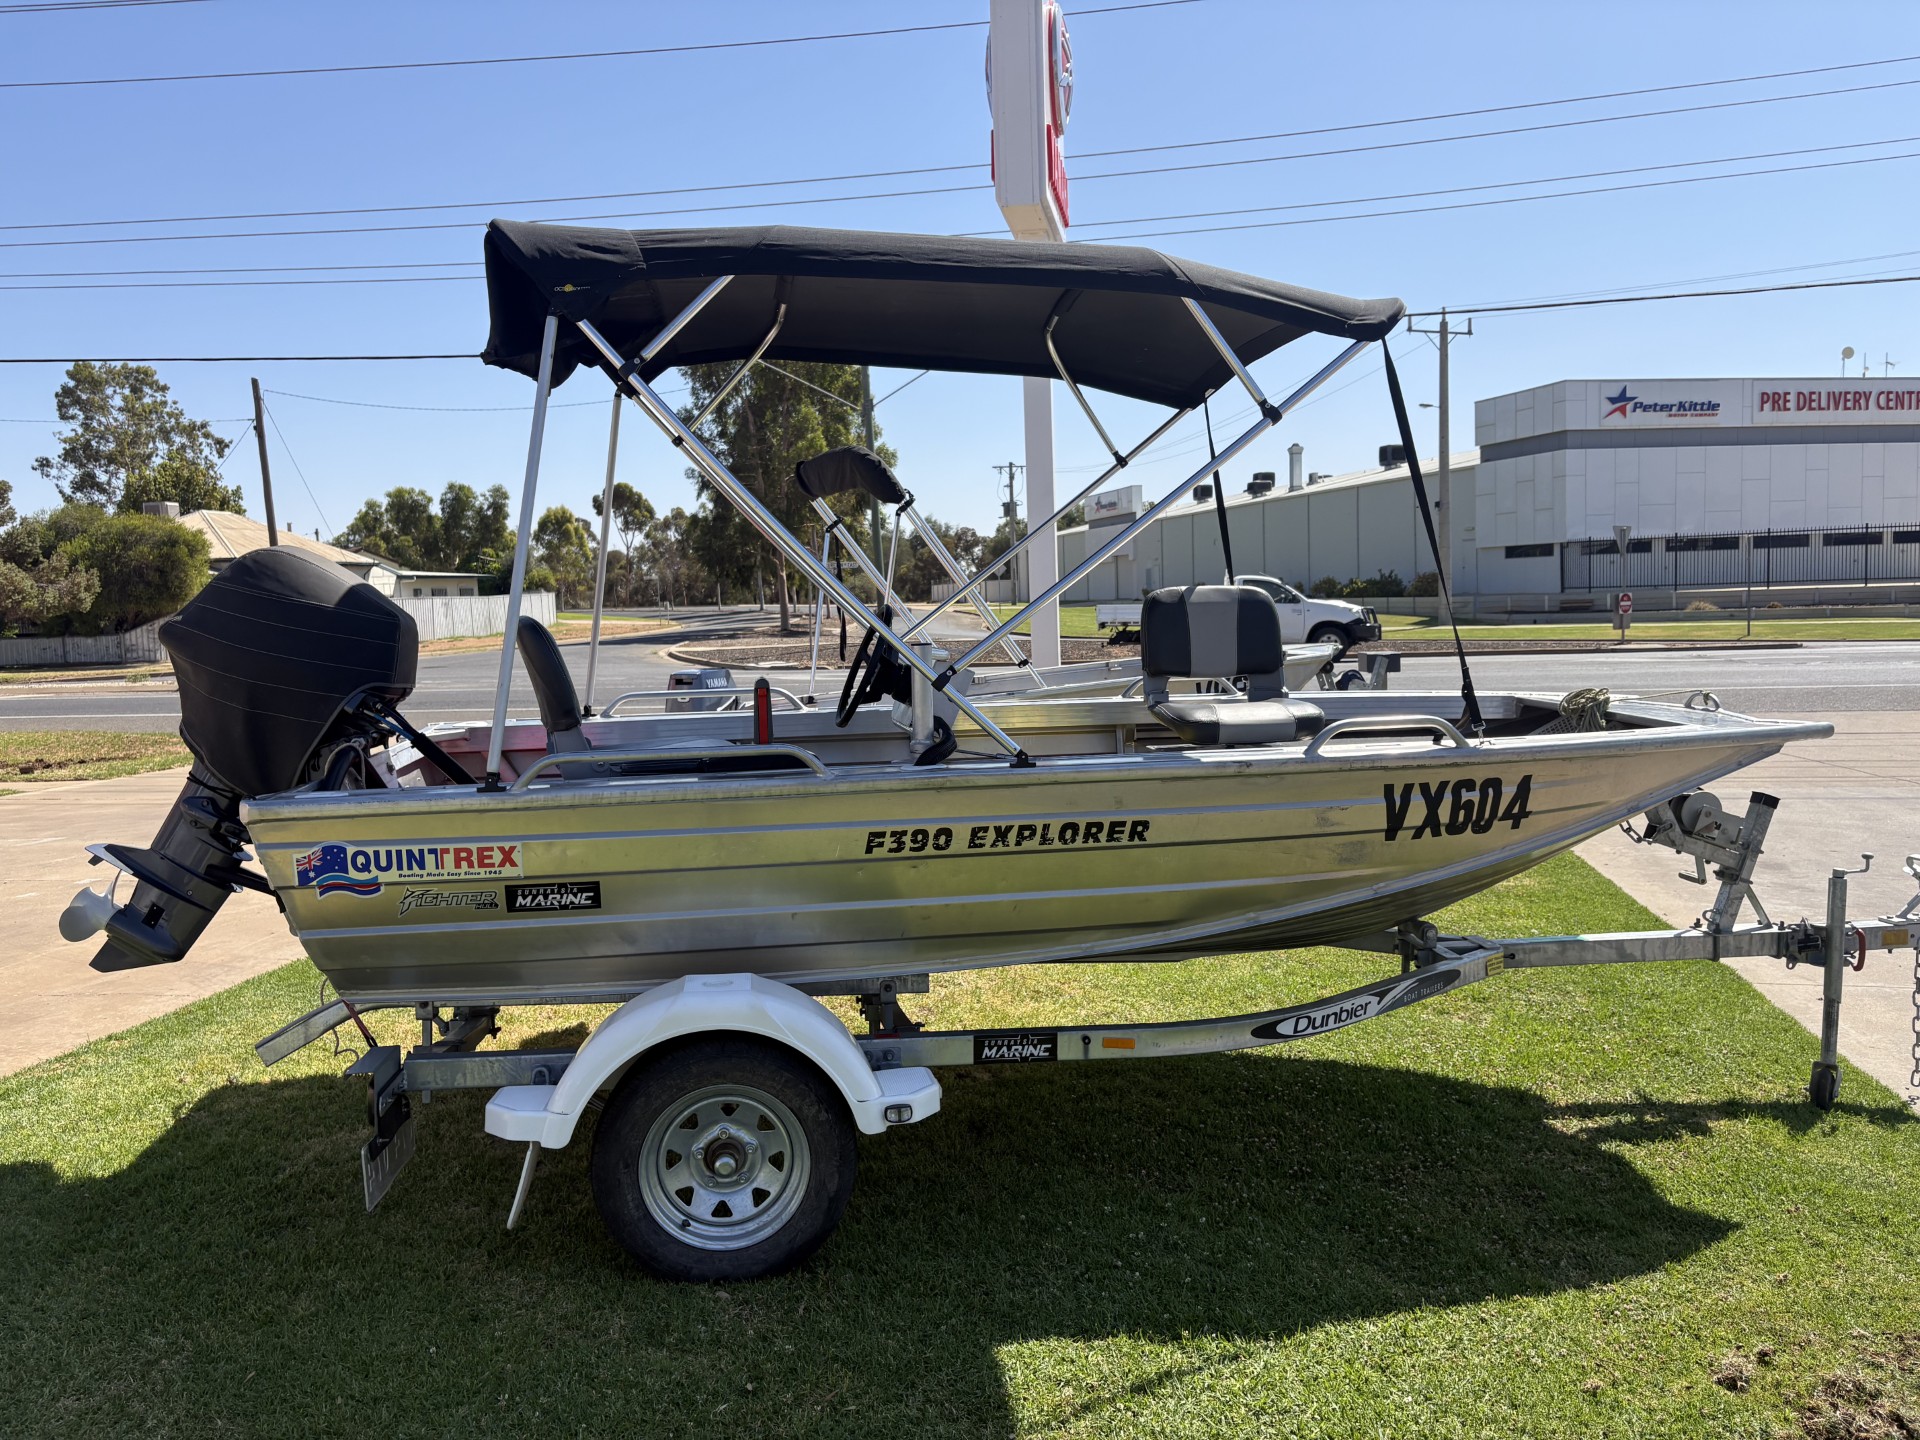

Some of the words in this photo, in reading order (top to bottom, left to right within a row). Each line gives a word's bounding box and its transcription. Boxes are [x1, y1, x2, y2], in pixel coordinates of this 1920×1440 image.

[1760, 391, 1791, 412] PRE
[1796, 391, 1872, 411] DELIVERY
[706, 677, 728, 689] YAMAHA
[1384, 774, 1533, 842] VX604
[865, 827, 954, 855] F390
[968, 819, 1151, 850] EXPLORER
[351, 845, 519, 875] QUINTREX
[515, 893, 594, 908] MARINE
[517, 887, 578, 896] SUNRAYSIA
[1293, 1000, 1372, 1035] Dunbier
[982, 1044, 1052, 1058] MARINE
[984, 1038, 1038, 1046] SUNRAYSIA
